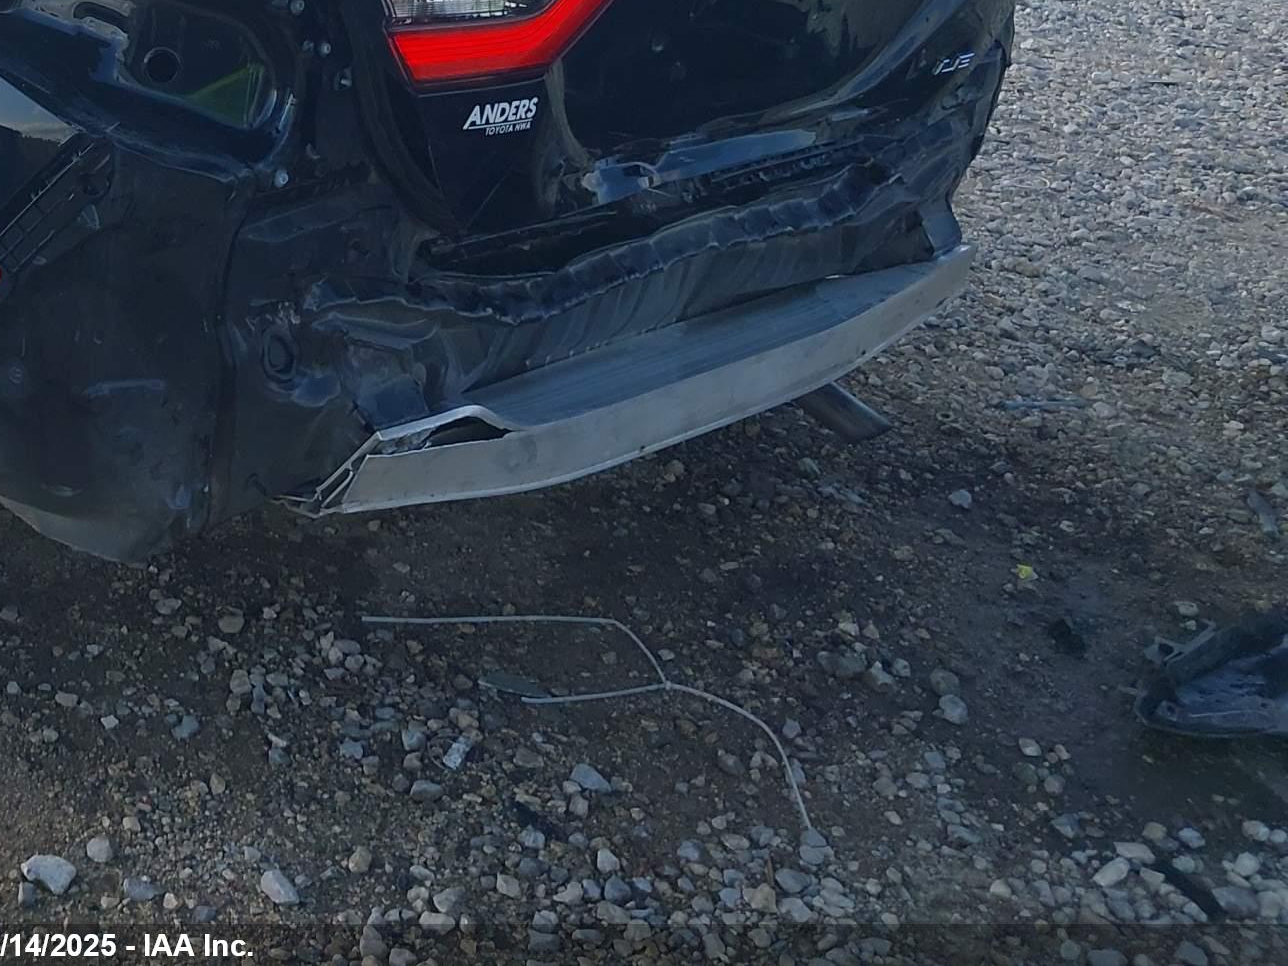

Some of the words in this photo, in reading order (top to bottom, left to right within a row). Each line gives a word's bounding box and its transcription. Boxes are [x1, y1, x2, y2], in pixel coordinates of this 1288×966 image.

[462, 96, 539, 130] ANDERS
[485, 124, 514, 136] TOYOTA
[514, 121, 531, 131] NWA
